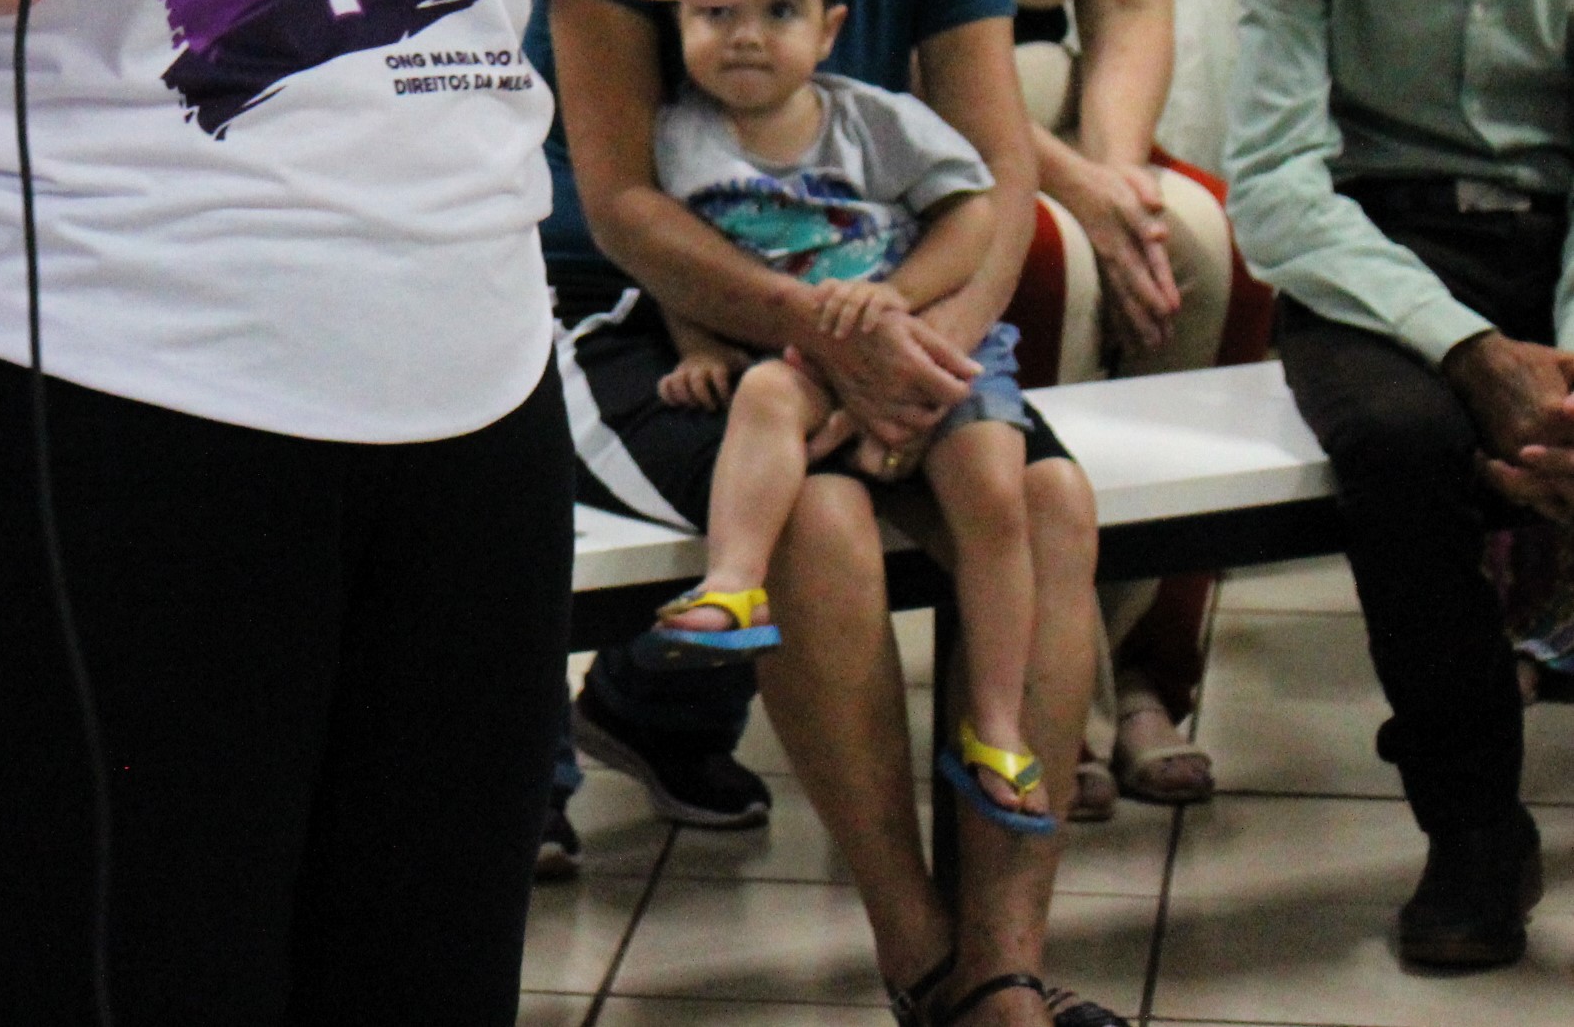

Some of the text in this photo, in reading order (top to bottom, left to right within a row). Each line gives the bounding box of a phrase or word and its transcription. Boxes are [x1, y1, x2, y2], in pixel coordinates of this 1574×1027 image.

[385, 53, 426, 70] ONG
[430, 50, 482, 66] MARIA
[485, 49, 512, 66] DO
[394, 74, 470, 96] DIREITOS
[474, 73, 493, 90] DA
